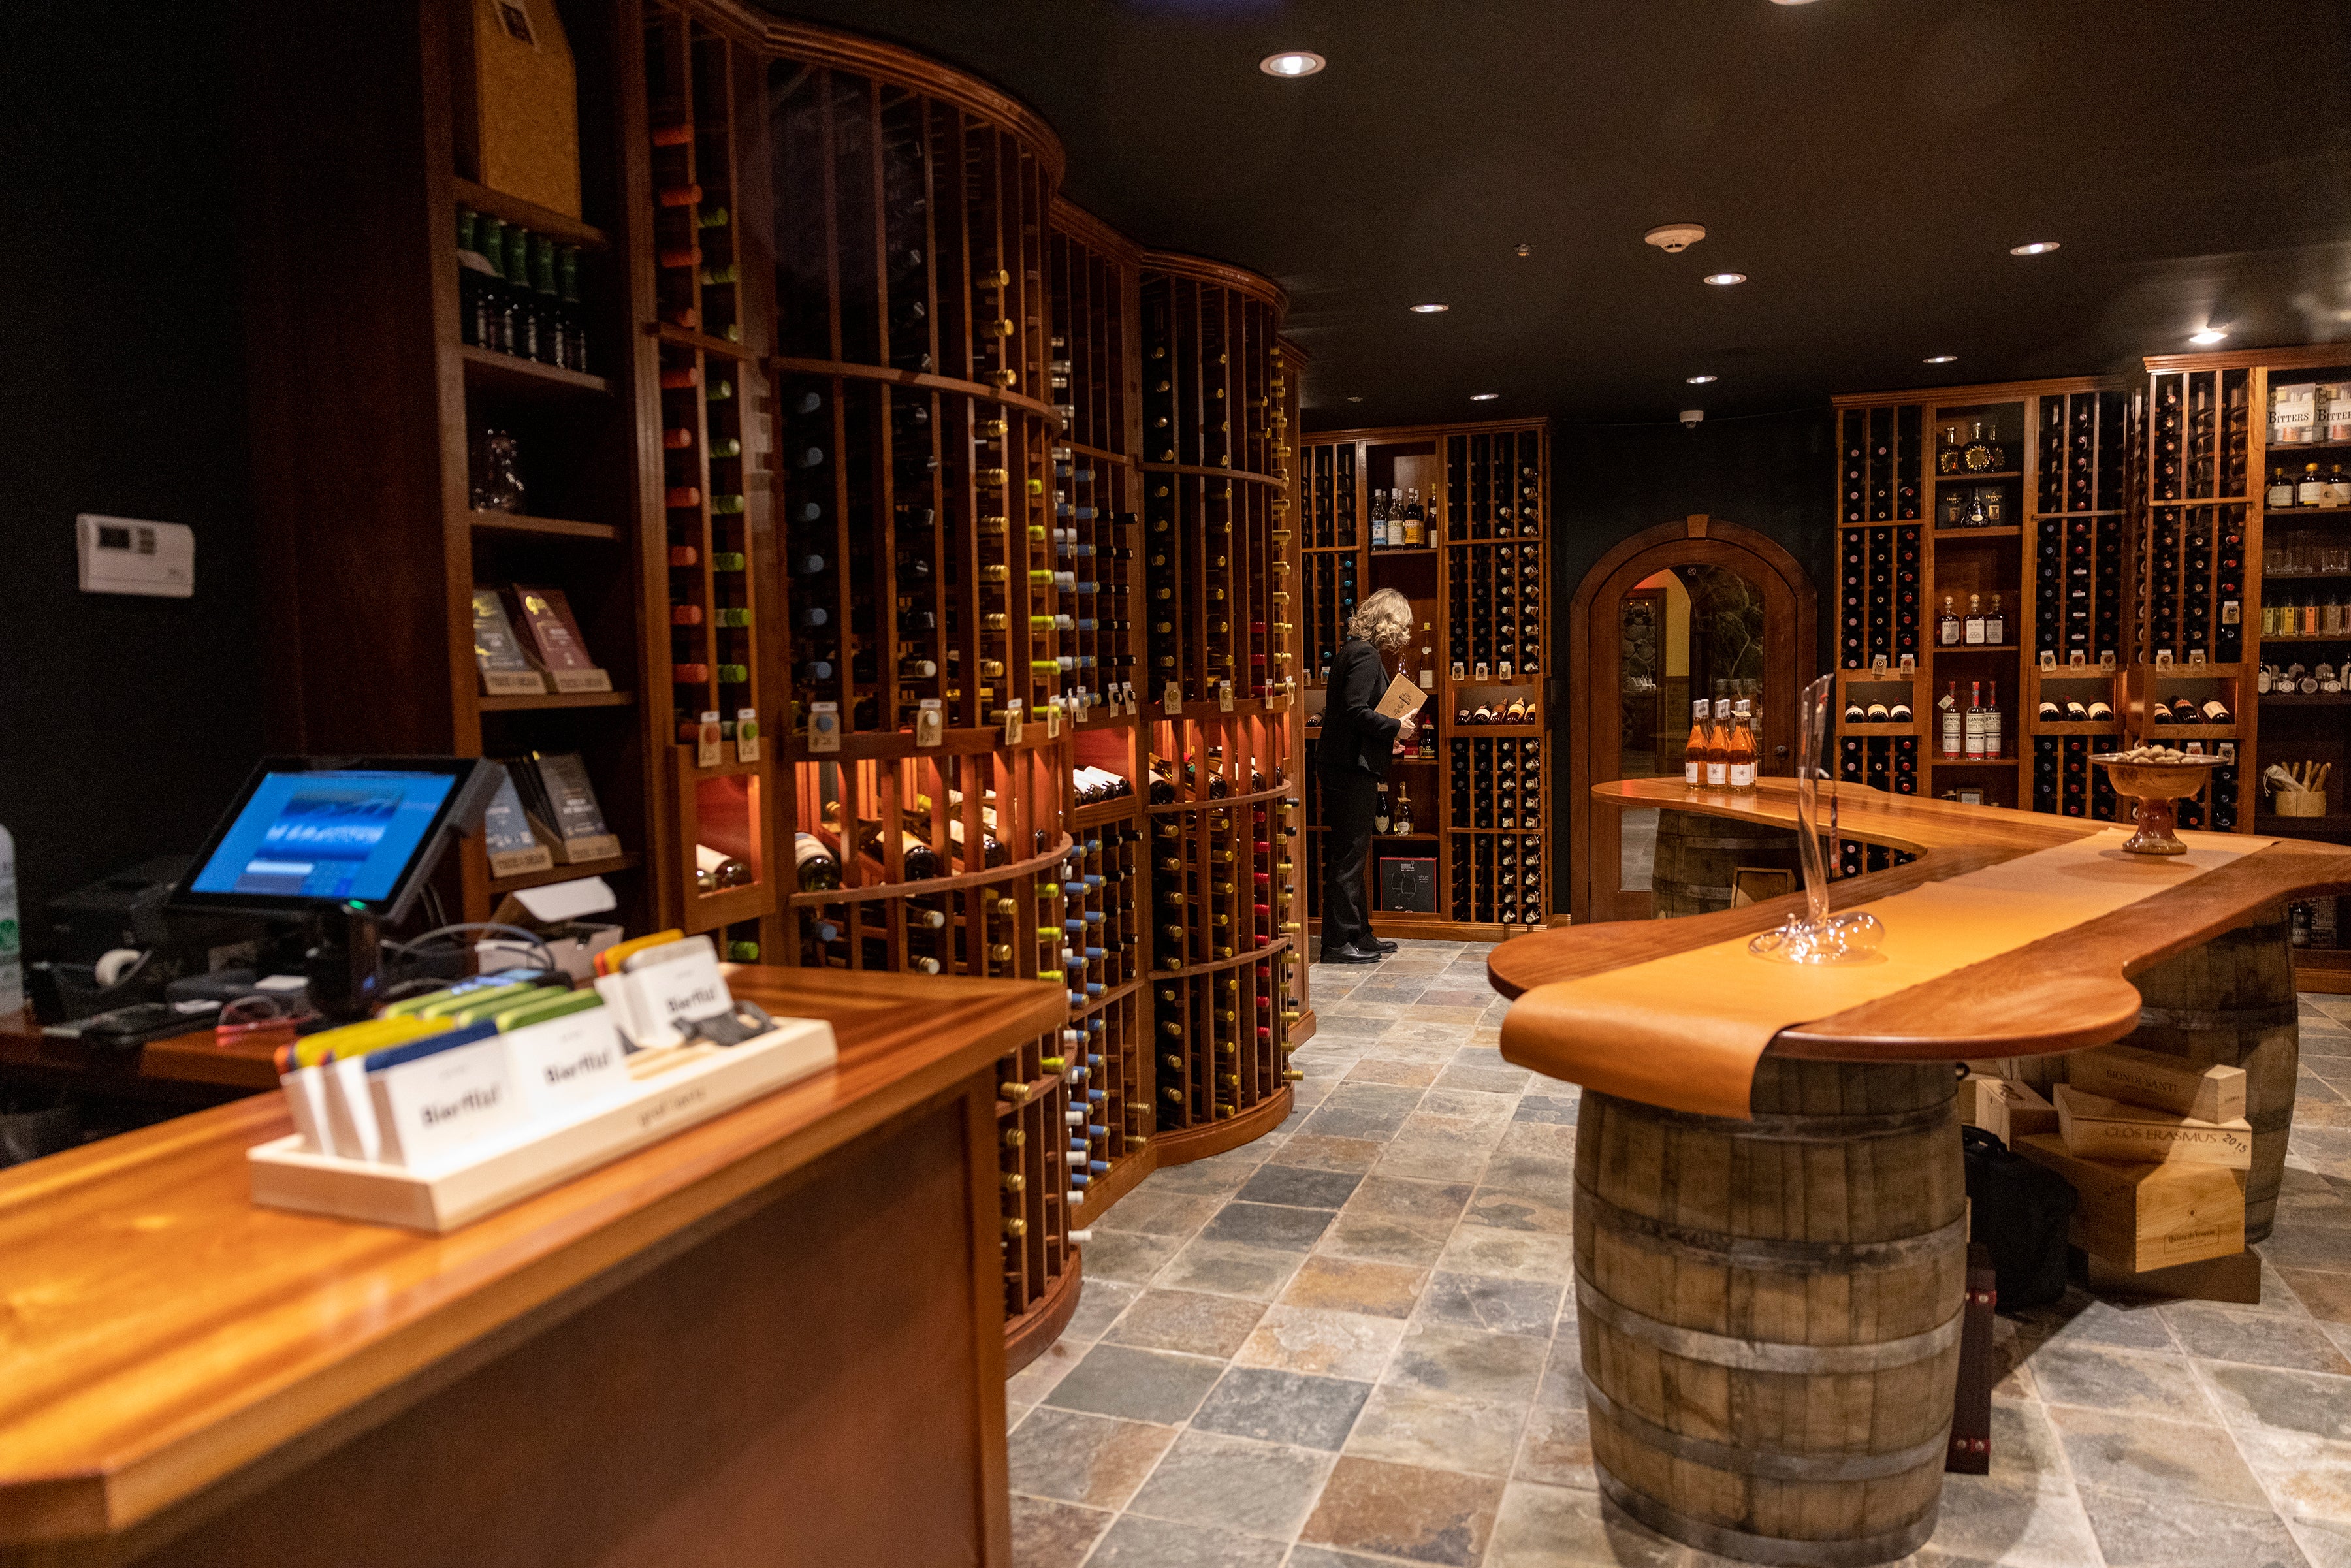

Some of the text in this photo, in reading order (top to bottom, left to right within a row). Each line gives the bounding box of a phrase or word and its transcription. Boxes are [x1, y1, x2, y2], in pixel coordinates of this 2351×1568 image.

[2268, 411, 2309, 423] BITTERS
[2105, 1127, 2248, 1153] CLOS ERASMUS 2015
